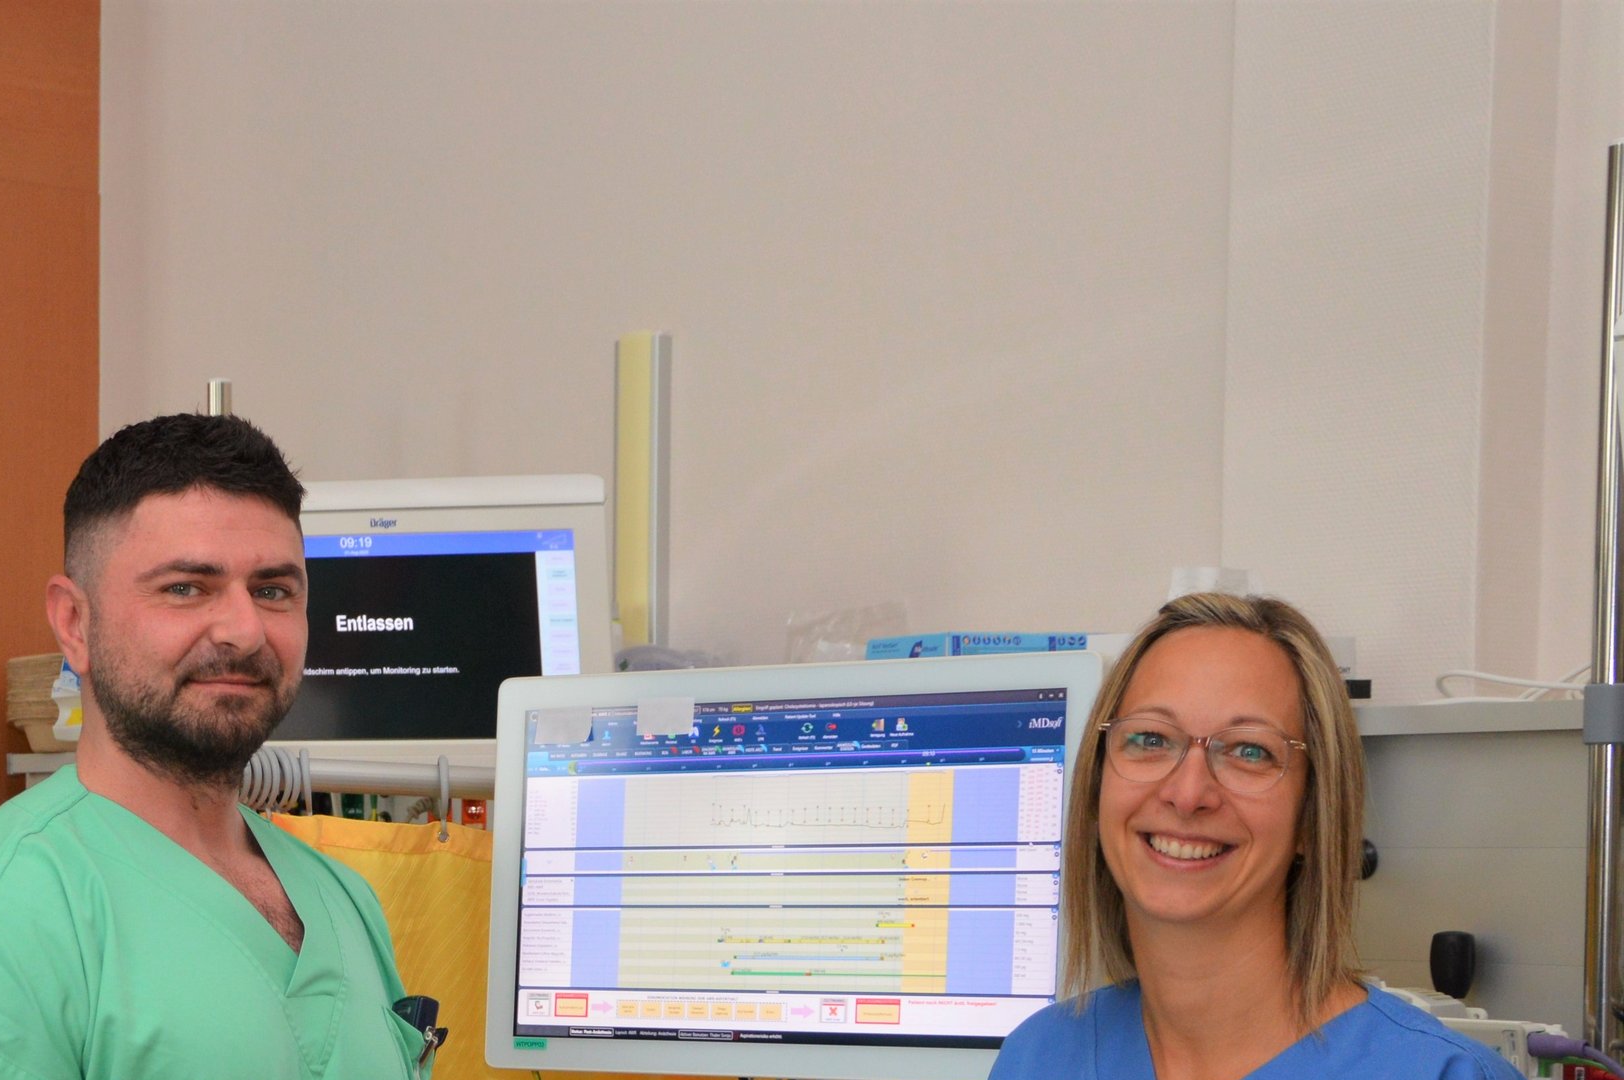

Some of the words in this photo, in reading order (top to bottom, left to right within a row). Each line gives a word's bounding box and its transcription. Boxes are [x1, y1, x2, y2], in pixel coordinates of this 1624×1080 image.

[340, 536, 373, 548] 09:19
[335, 614, 414, 632] Entlassen
[382, 666, 421, 676] Monitoring
[432, 666, 460, 674] starten.
